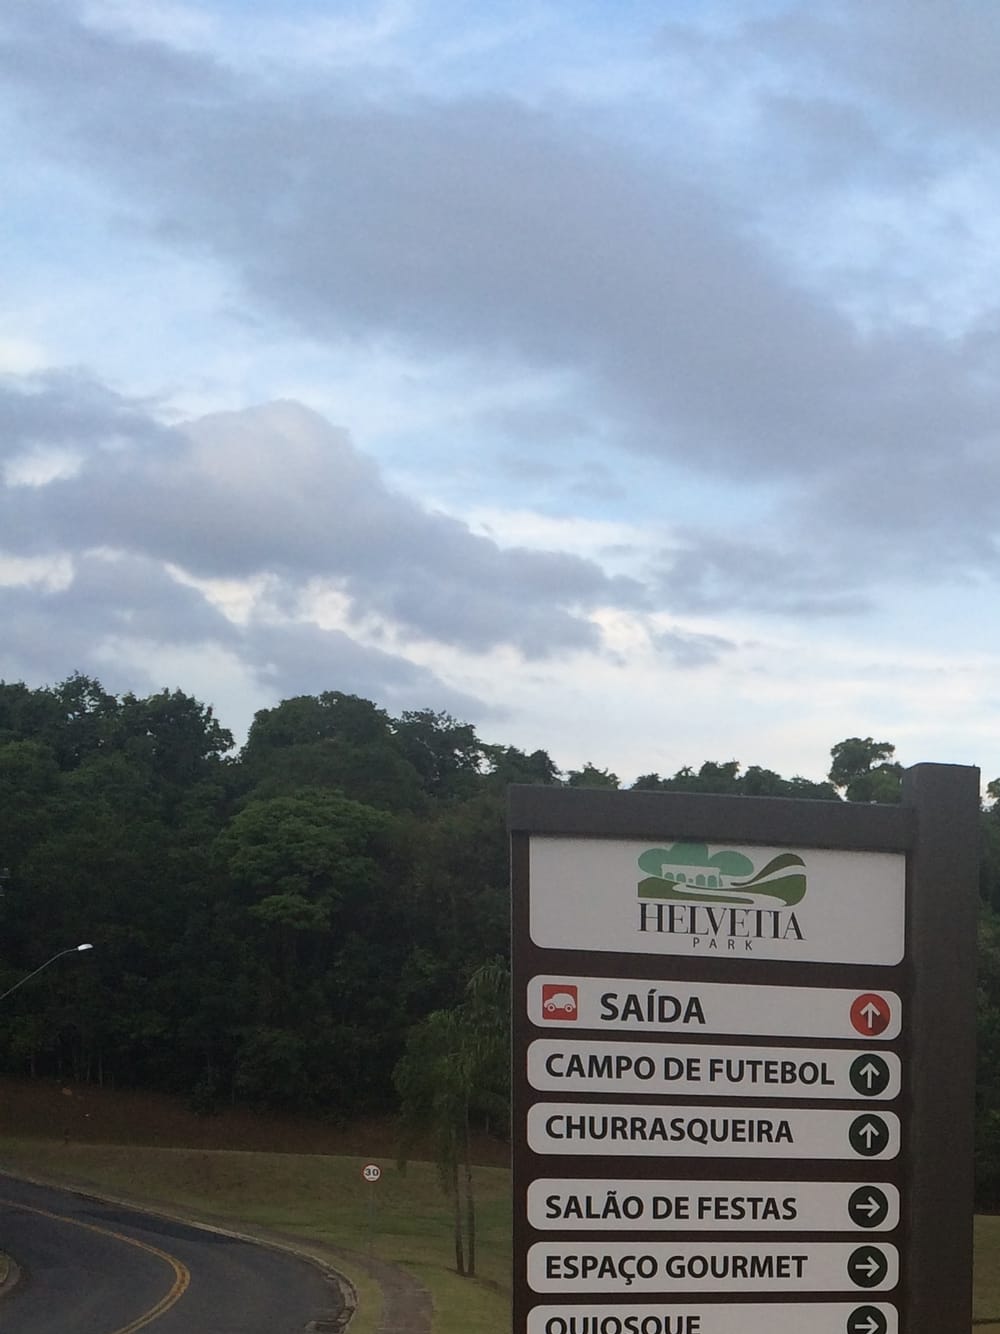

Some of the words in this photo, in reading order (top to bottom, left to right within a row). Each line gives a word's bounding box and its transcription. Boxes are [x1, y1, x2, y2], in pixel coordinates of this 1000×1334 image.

[637, 902, 806, 941] HELVETIA
[692, 937, 753, 951] PARK
[600, 989, 706, 1025] SAÍDA
[545, 1053, 655, 1080] CAMPO
[664, 1059, 700, 1082] DE
[709, 1059, 835, 1086] FUTEBOL
[545, 1115, 793, 1145] CHURRASQUEIRA
[366, 1168, 378, 1176] 30
[545, 1191, 644, 1219] SALÃO
[652, 1196, 689, 1220] DE
[698, 1197, 797, 1221] FESTAS
[545, 1255, 657, 1285] ESPAÇO
[665, 1255, 808, 1278] GOURMET
